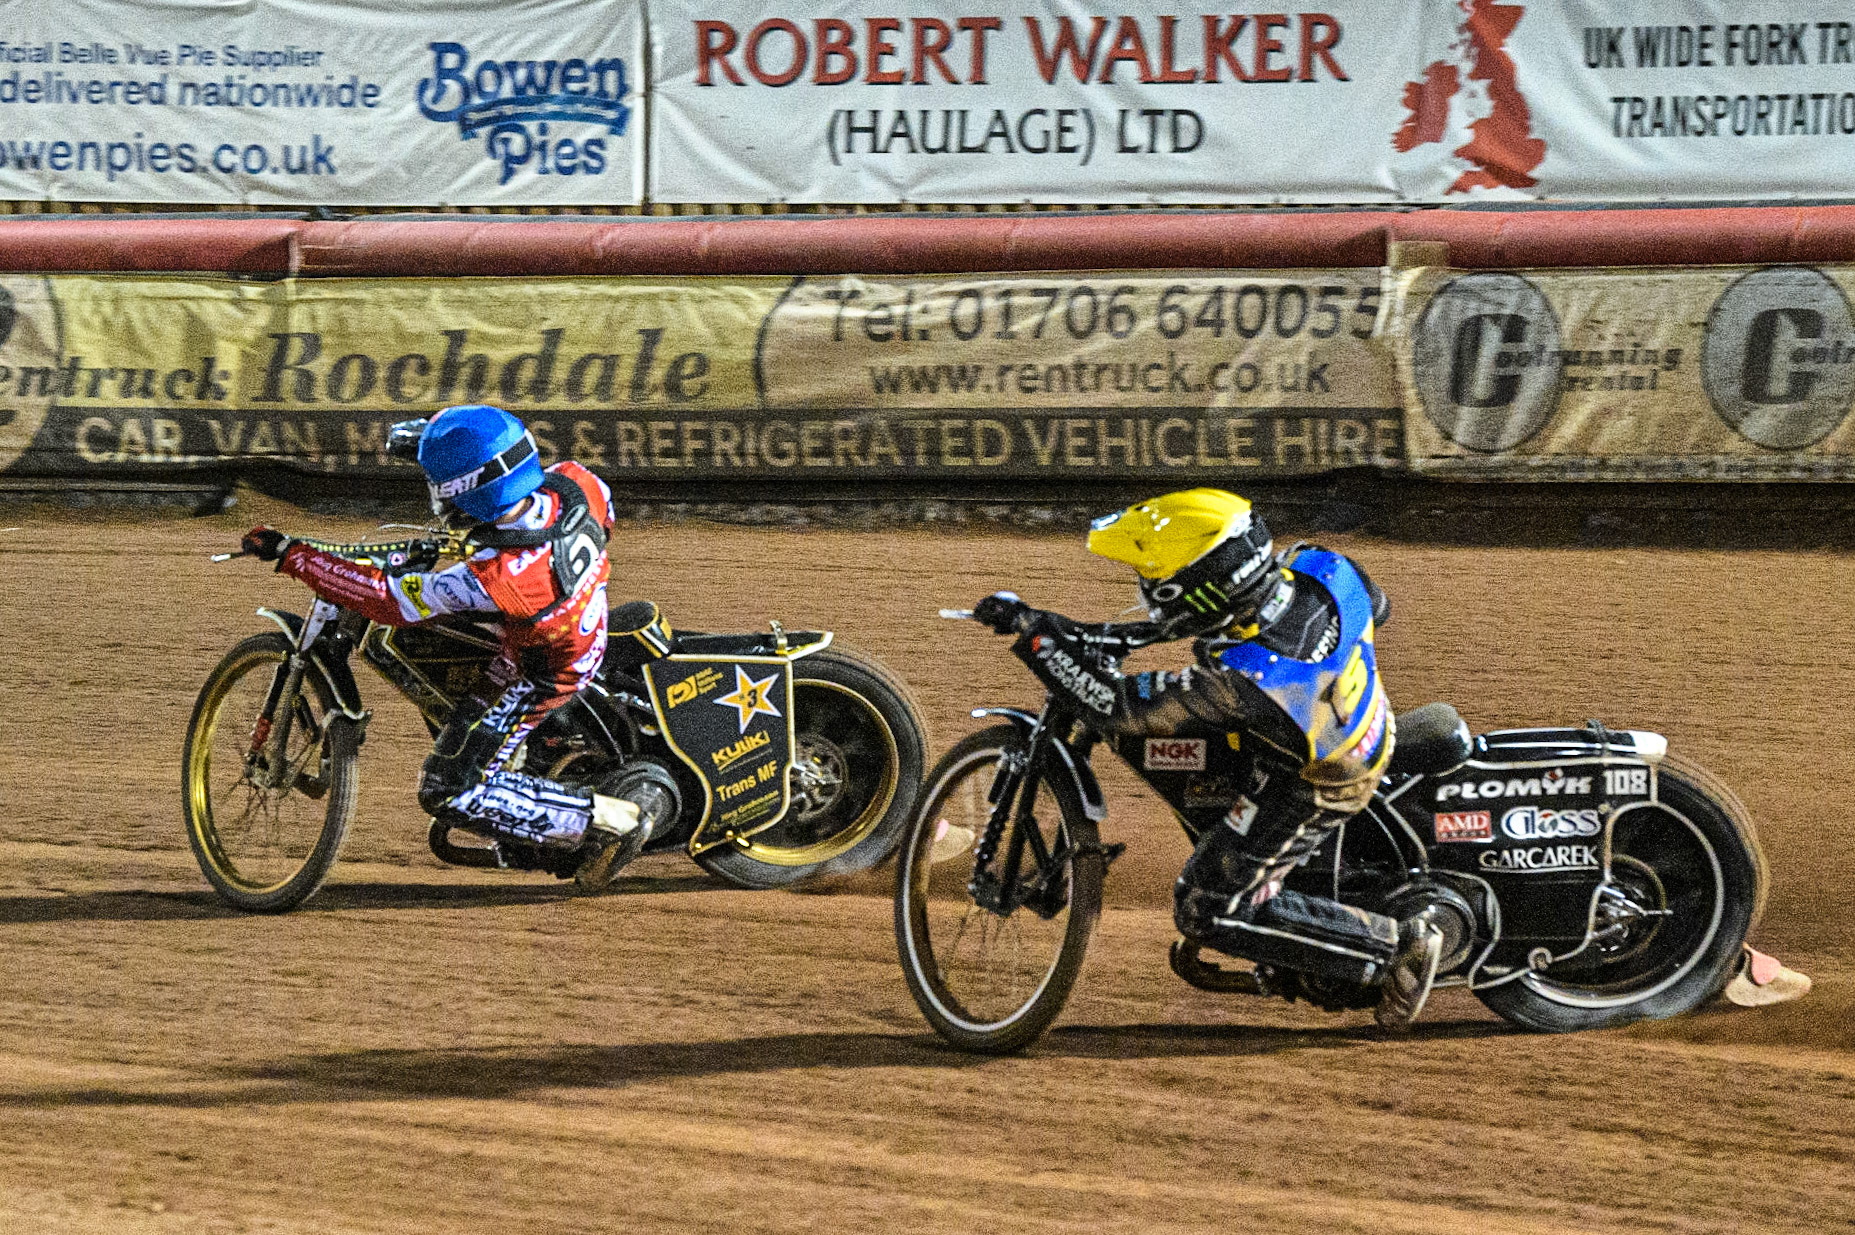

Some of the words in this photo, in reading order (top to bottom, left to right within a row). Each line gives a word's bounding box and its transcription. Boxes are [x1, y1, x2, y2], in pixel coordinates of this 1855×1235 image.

[59, 42, 118, 64] Belle
[177, 44, 214, 66] Pie
[219, 44, 324, 72] Supplier
[692, 16, 1002, 87] ROBERT
[1021, 13, 1352, 86] WALKER
[1583, 26, 1626, 69] UK
[1631, 25, 1715, 67] WIDE
[1724, 23, 1808, 66] FORK
[0, 71, 169, 105] delivered
[177, 75, 382, 108] nationwide
[418, 42, 630, 122] Bowen
[488, 121, 607, 185] Pies
[827, 107, 1096, 166] (HAULAGE)
[1115, 108, 1207, 153] LTD
[950, 285, 1138, 341] 01706
[1156, 283, 1384, 340] 640055
[252, 327, 712, 402] Rochdale
[870, 351, 1332, 396] www.rentruck.co.uk
[617, 418, 1017, 468] REFRIGERATED
[1025, 417, 1262, 468] VEHICLE
[1275, 417, 1401, 468] HIRE
[1150, 742, 1200, 760] NGK
[716, 776, 757, 802] Trans
[757, 760, 779, 783] MF
[1602, 769, 1649, 796] 108
[1439, 814, 1488, 831] AMD
[1480, 844, 1600, 869] GARCAREK
